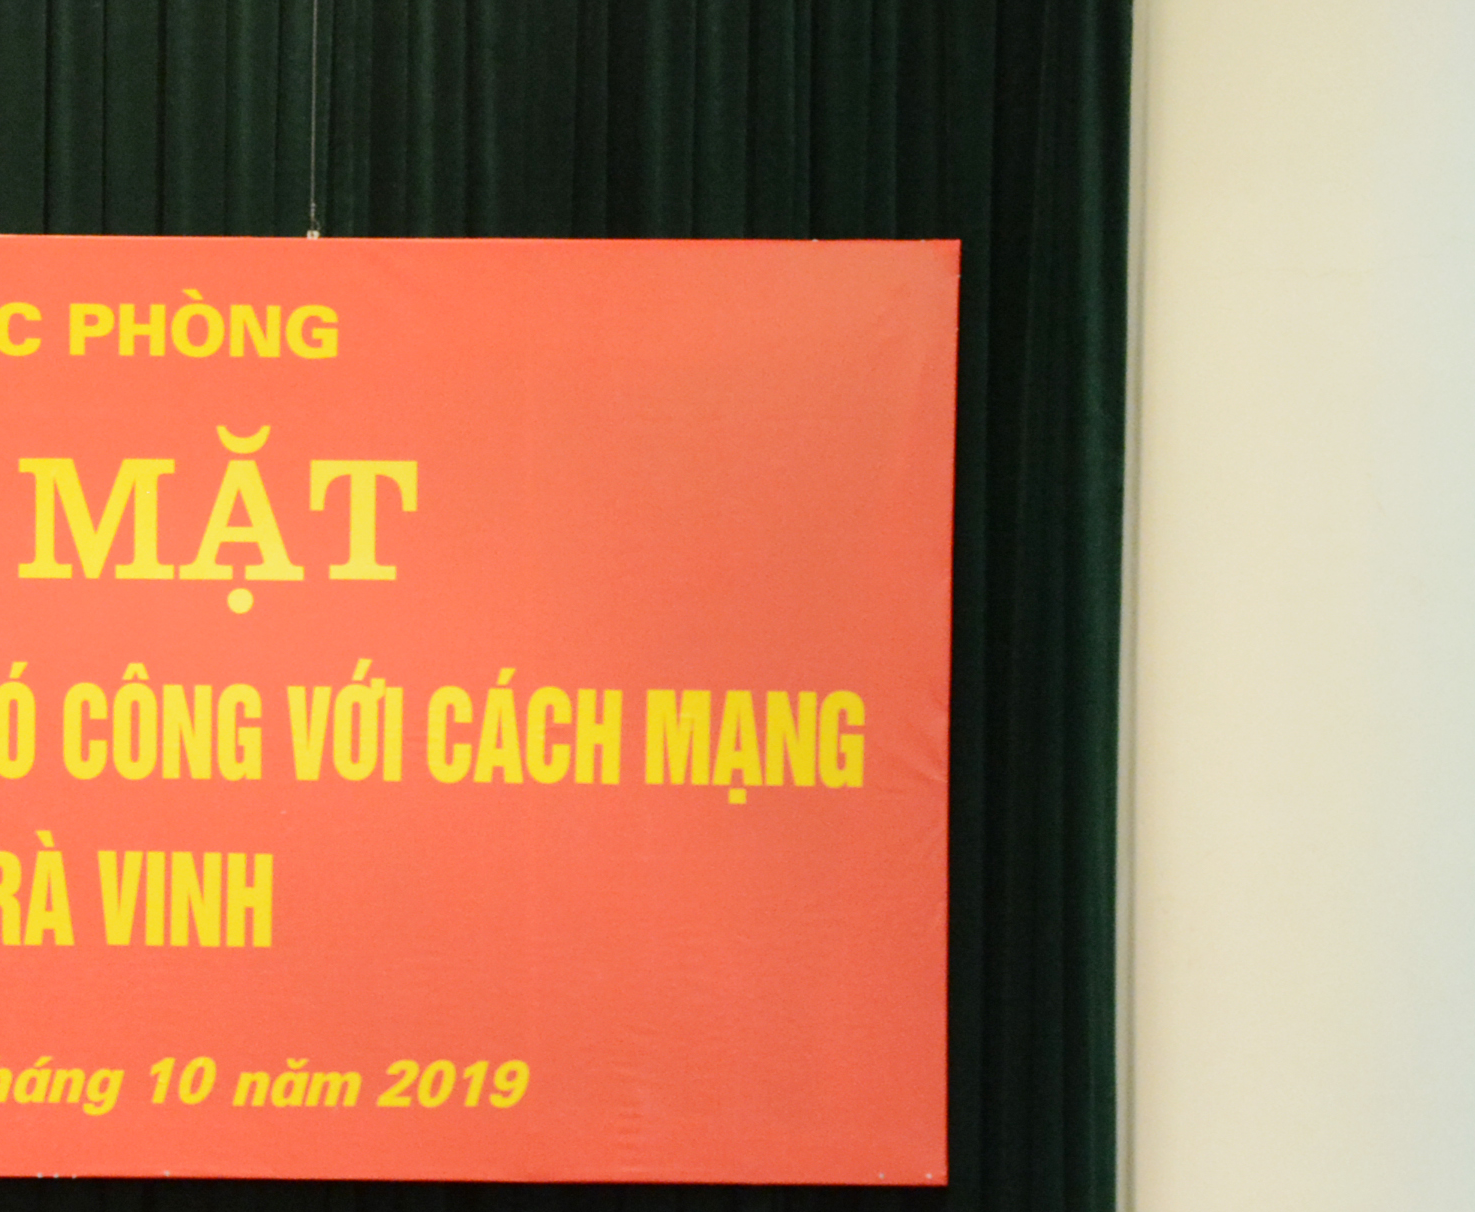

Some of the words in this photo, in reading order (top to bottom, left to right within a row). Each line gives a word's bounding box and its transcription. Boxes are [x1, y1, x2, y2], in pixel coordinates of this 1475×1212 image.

[70, 289, 337, 358] PHÒNG
[19, 426, 417, 613] MẶT
[64, 662, 261, 780] CÔNG
[288, 659, 403, 781] VỚI
[428, 668, 622, 784] CÁCH
[646, 690, 864, 803] MẠNG
[99, 851, 272, 947] VINH
[151, 1058, 216, 1104] 10
[234, 1059, 361, 1106] năm
[378, 1061, 529, 1107] 2019
